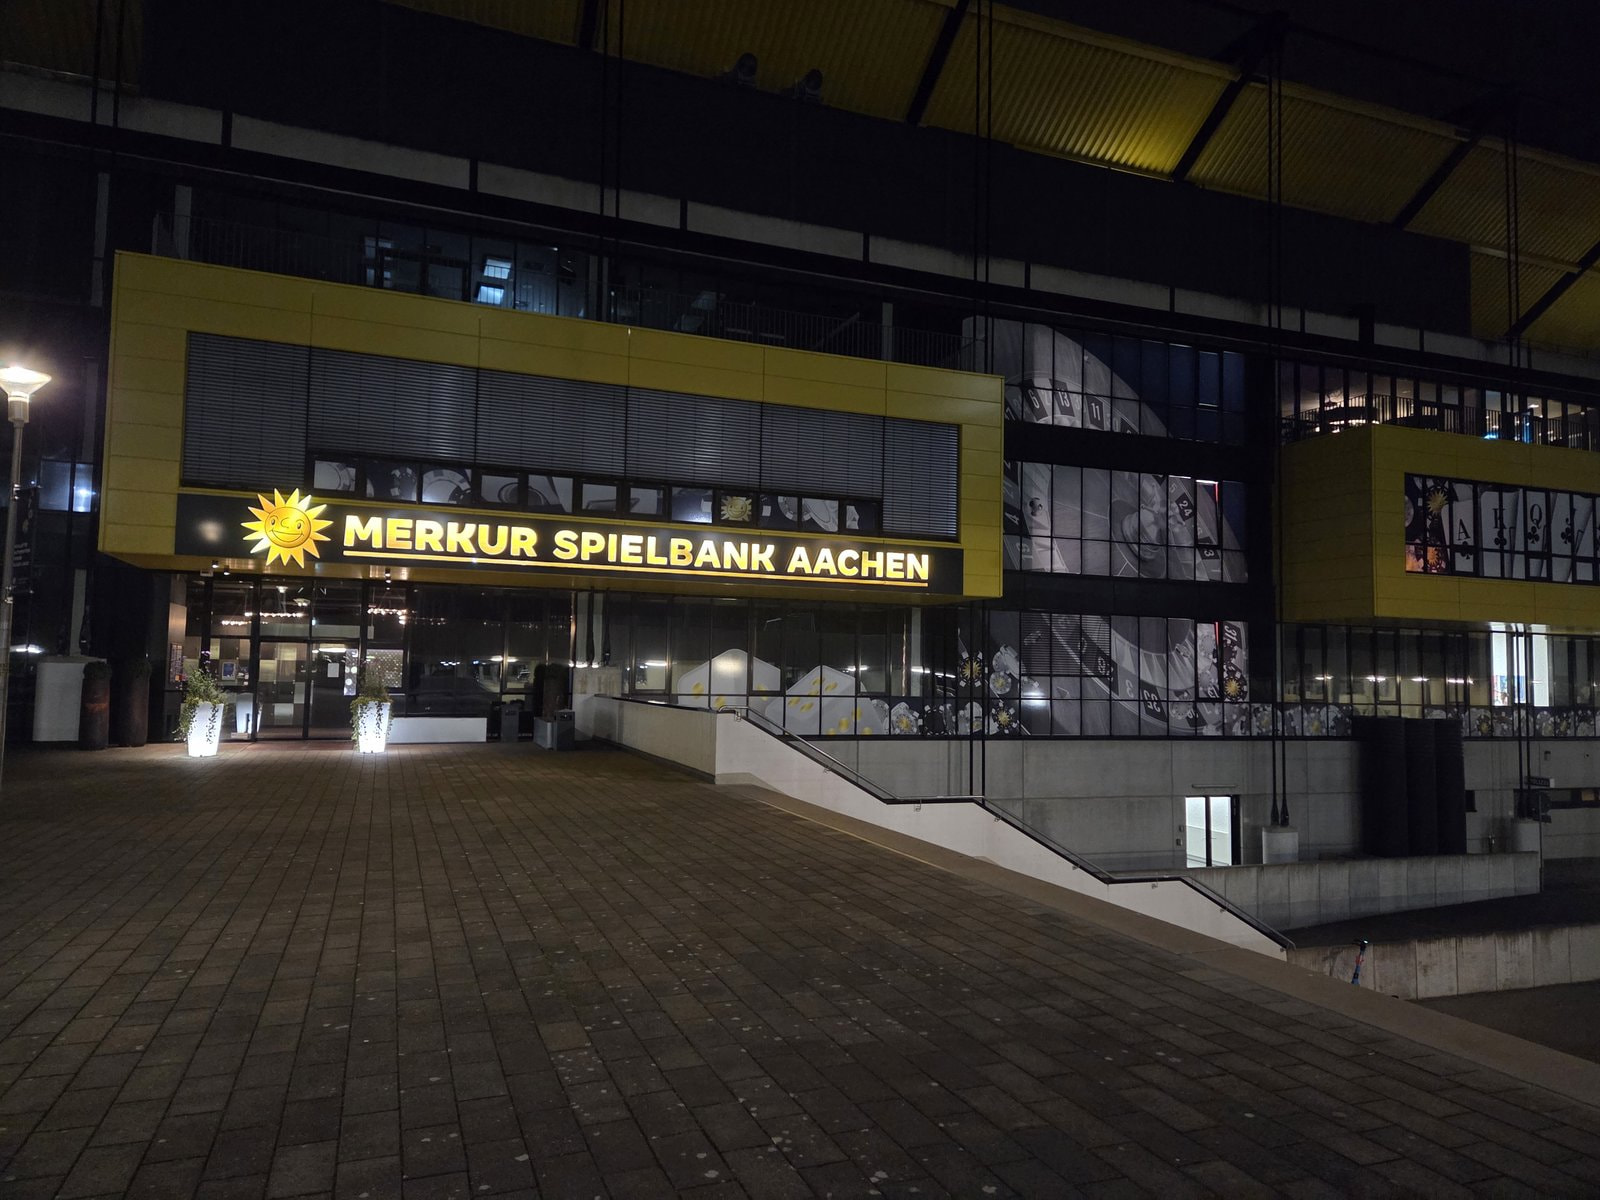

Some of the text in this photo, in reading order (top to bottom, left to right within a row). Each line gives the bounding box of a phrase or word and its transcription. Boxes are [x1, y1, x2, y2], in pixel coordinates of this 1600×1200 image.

[1091, 402, 1101, 421] 11
[1178, 500, 1193, 517] 24
[1457, 518, 1471, 541] A
[1530, 503, 1543, 530] Q
[343, 514, 930, 581] MERKUR SPIELBANK AACHEN
